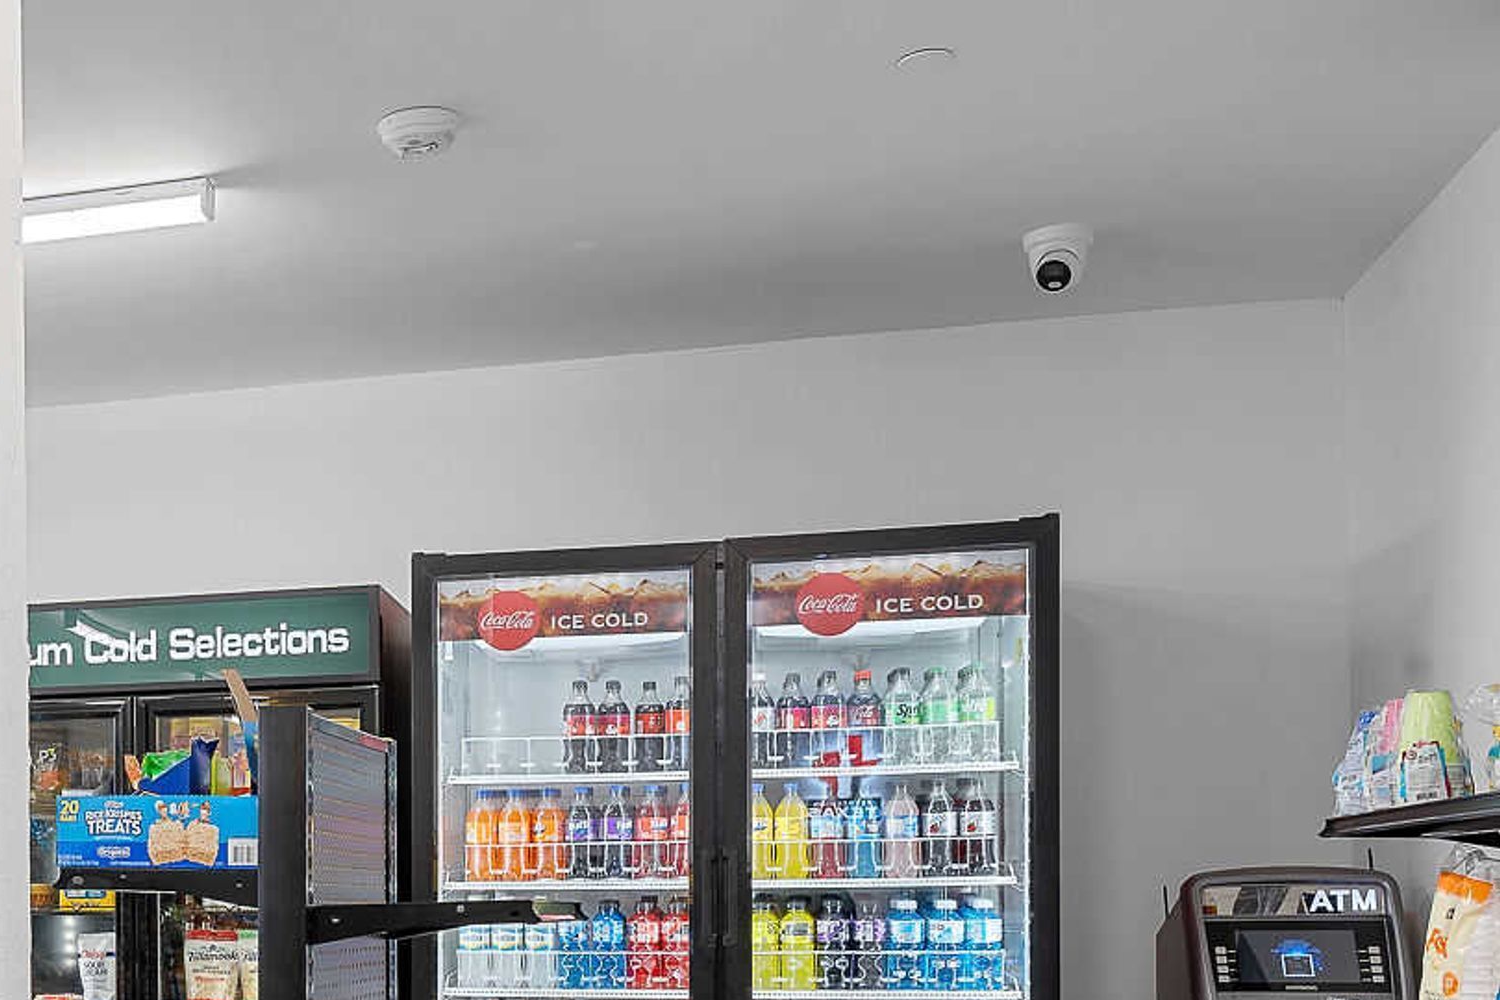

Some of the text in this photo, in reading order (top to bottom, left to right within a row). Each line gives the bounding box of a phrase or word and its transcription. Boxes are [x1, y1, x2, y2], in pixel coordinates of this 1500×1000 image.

[876, 594, 984, 613] ICE COLD
[551, 612, 648, 630] ICE COLD
[84, 627, 157, 665] Cold
[168, 622, 350, 661] Selections
[59, 800, 79, 814] 20
[87, 819, 142, 835] TREATS
[1309, 888, 1378, 913] ATM
